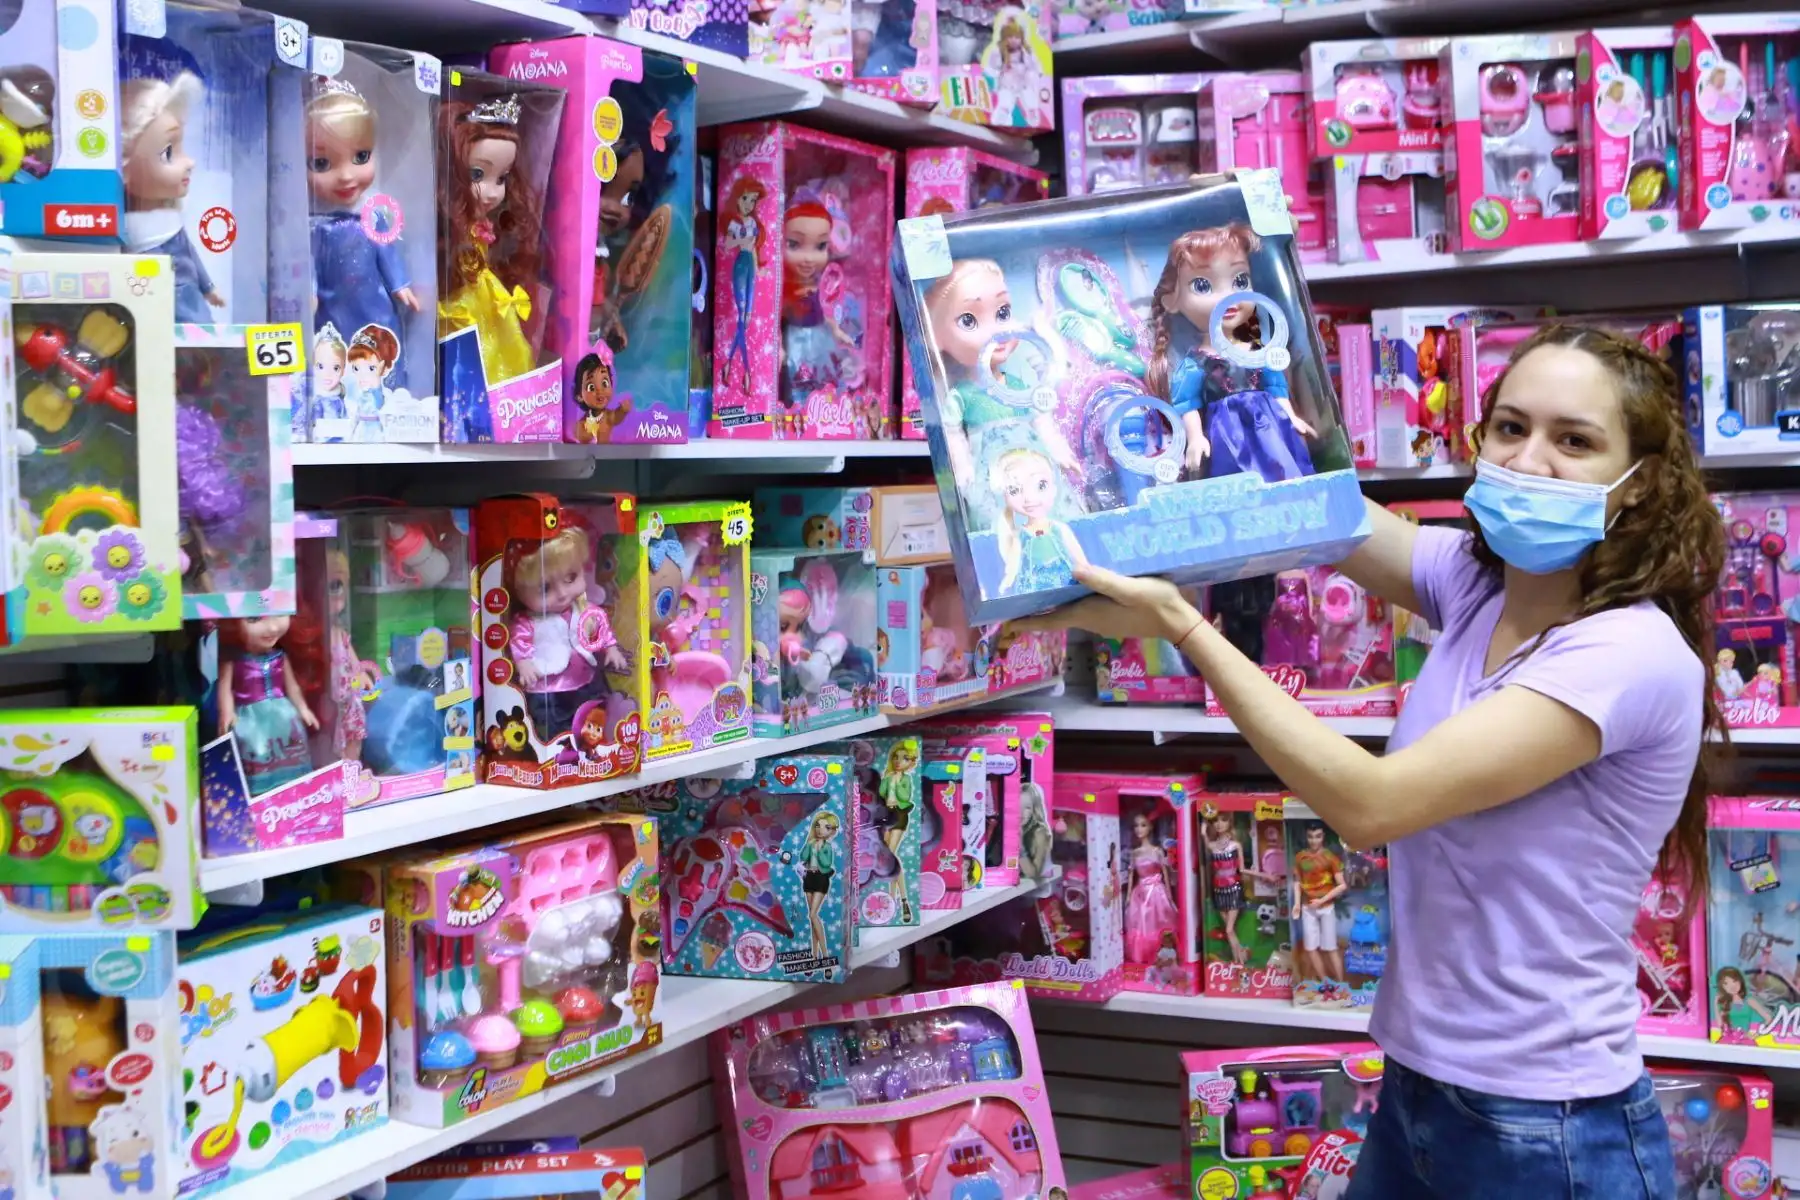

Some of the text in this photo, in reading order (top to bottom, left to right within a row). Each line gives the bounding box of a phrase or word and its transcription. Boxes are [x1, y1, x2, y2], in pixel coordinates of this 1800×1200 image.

[281, 32, 298, 48] 3+
[508, 60, 568, 80] MOANA
[1399, 134, 1428, 147] Mini
[55, 209, 112, 228] 6m+
[255, 329, 294, 341] OFERTA
[256, 342, 294, 367] 65
[497, 384, 563, 428] PRINCESS
[384, 413, 435, 428] FASHION
[636, 420, 682, 439] MOANA
[728, 519, 744, 537] 45
[1101, 513, 1228, 562] WORLD
[1110, 660, 1145, 680] Barbie
[620, 723, 638, 736] 100
[260, 785, 333, 832] PRINCESS
[447, 891, 504, 926] KITCHEN
[778, 952, 812, 962] FASHION
[786, 958, 838, 973] MAKE-UP SET
[1002, 954, 1097, 982] World Dolls
[1208, 963, 1237, 982] Pet
[459, 1089, 487, 1109] COLOR
[1750, 1087, 1769, 1099] 3+
[482, 1159, 525, 1173] PLAY
[536, 1156, 569, 1168] SET
